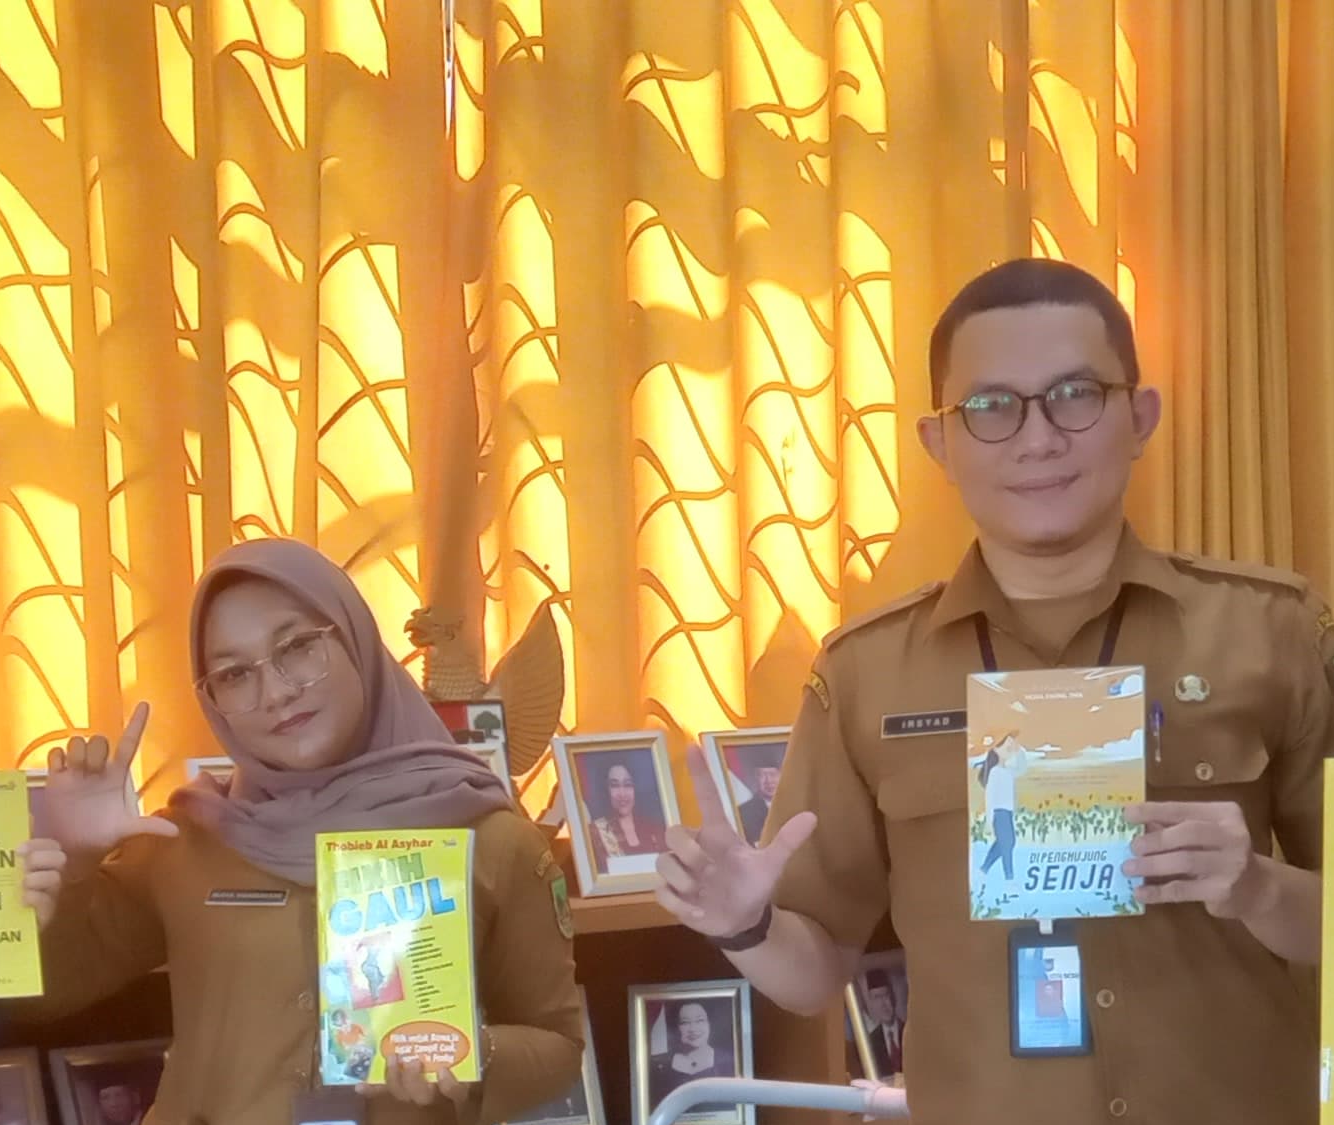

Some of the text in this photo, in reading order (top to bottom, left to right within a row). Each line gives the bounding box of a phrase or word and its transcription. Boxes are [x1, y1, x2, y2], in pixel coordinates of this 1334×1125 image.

[376, 840, 388, 849] Al
[391, 838, 434, 850] Asyhar
[1024, 864, 1114, 891] SENJA
[328, 877, 456, 937] GAUL
